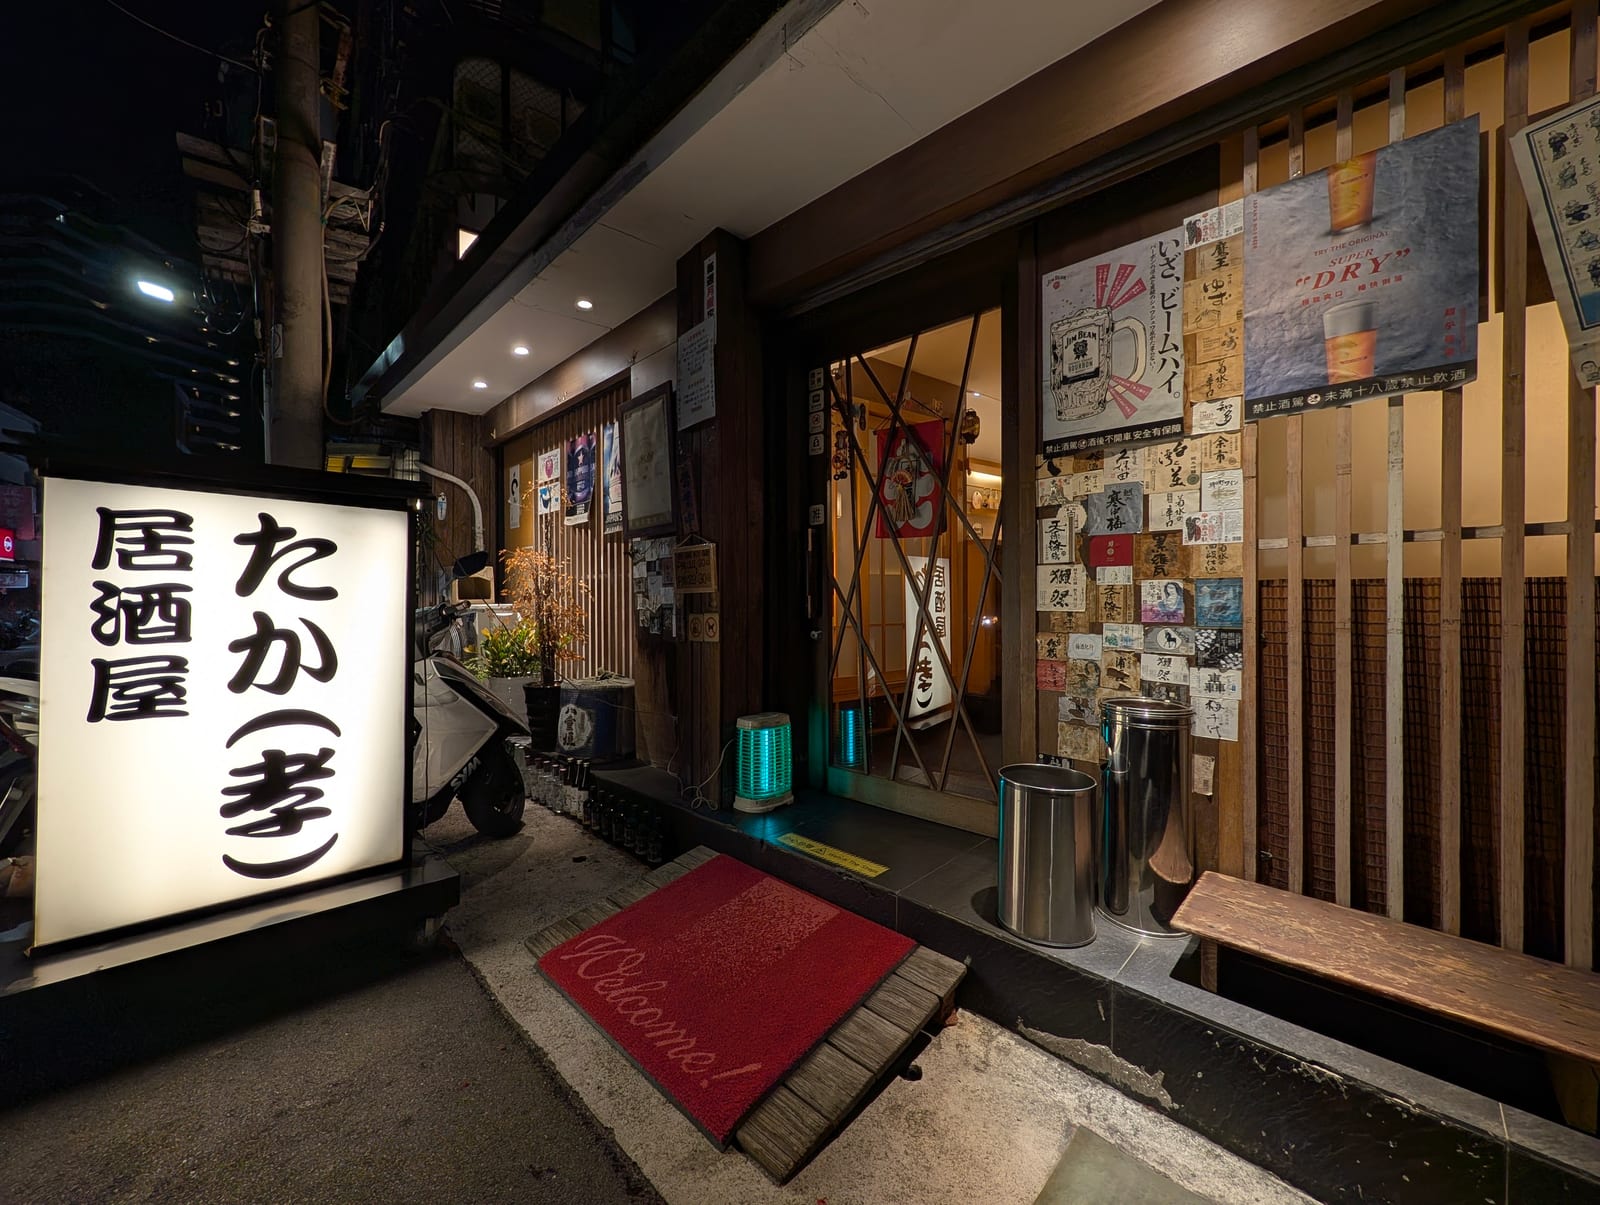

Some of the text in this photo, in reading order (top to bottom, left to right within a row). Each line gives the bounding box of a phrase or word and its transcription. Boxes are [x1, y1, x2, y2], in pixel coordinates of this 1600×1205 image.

[1314, 231, 1390, 257] TRY THE ORIGINAL
[1329, 248, 1374, 268] SUPER
[1157, 238, 1181, 399] いざ、ビームハイ。
[1064, 331, 1097, 349] JIM BEAM
[1251, 368, 1467, 415] 禁止酒駕 未滿十八歲禁止飲酒
[1045, 440, 1078, 454] 禁止酒駕
[1113, 448, 1130, 481] 久保田
[1049, 568, 1073, 609] 獺祭
[86, 506, 194, 723] 居酒屋
[450, 756, 482, 792] SYM
[560, 934, 762, 1089] Welcome!
